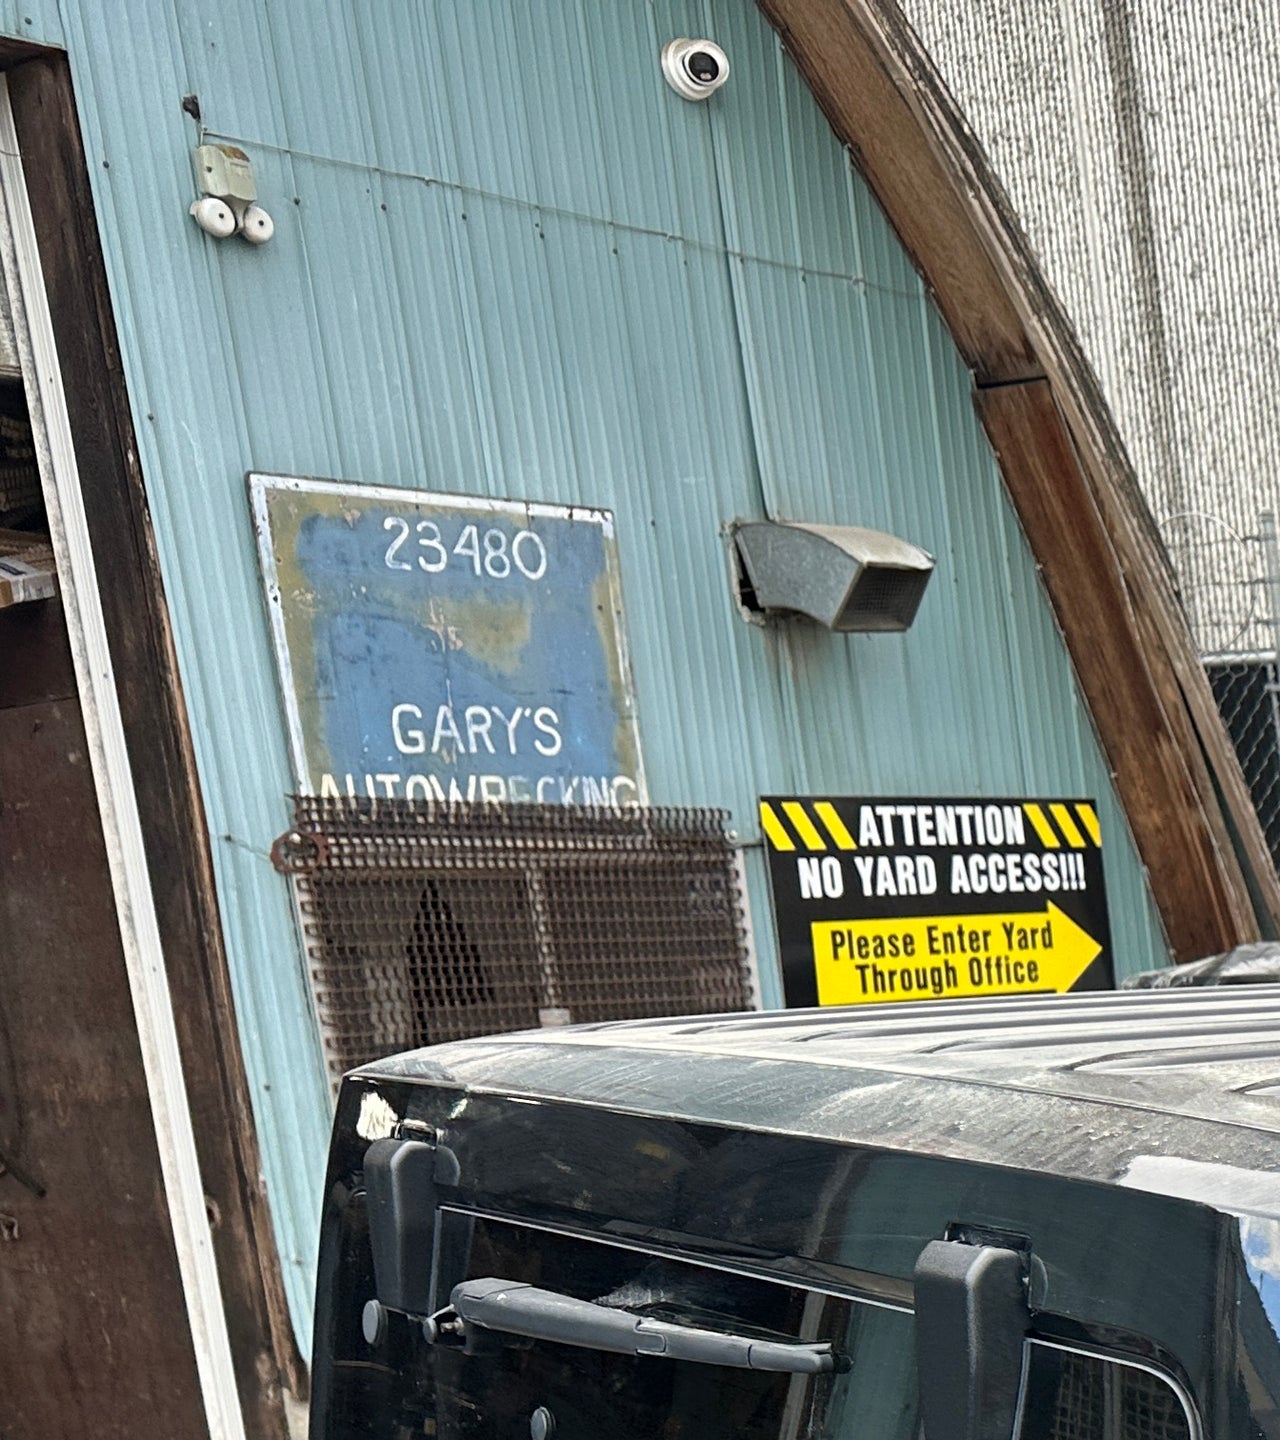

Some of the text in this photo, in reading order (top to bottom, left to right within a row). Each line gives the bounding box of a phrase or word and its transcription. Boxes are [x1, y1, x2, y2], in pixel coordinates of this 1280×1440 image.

[383, 516, 547, 580] 23480
[391, 704, 562, 756] GARY'S
[859, 805, 1026, 847] ATTENTION
[797, 853, 1087, 899] NO YARD ACCESS!!!
[830, 921, 1054, 961] Please Enter Yard
[855, 955, 1039, 994] Through Office
